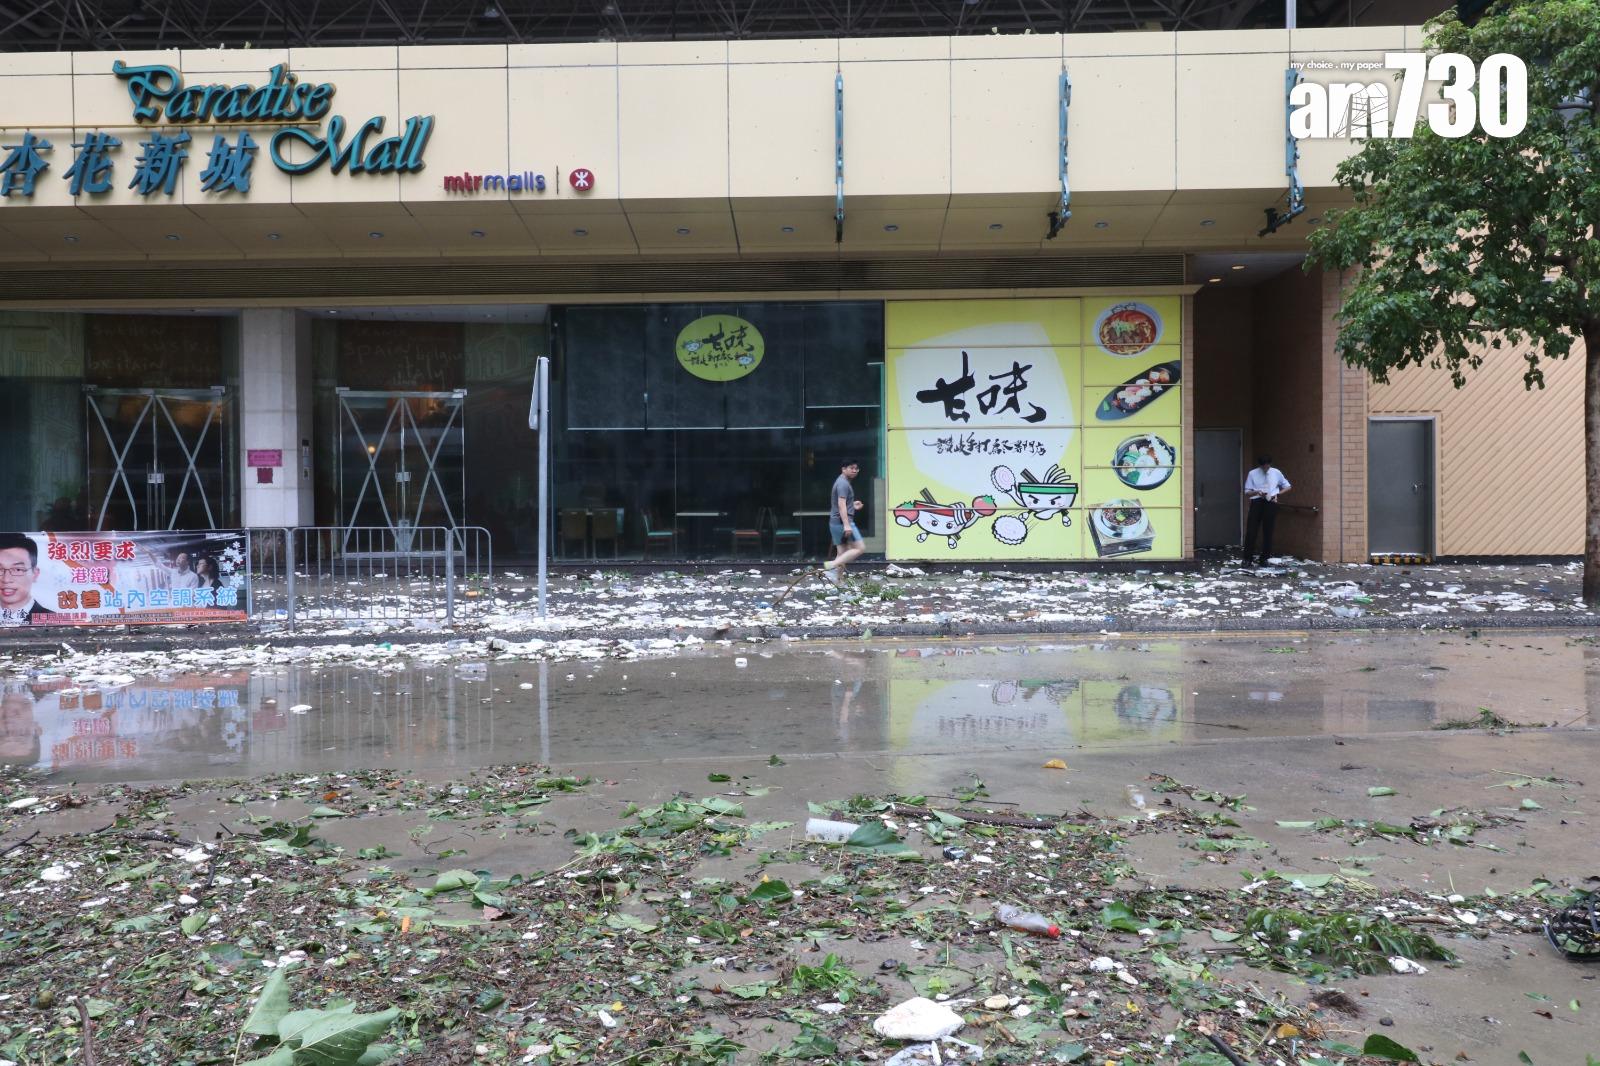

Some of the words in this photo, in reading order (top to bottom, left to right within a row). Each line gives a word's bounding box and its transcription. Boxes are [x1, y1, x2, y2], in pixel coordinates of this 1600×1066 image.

[112, 60, 336, 123] Paradise
[0, 130, 260, 197] 杏花新城
[270, 115, 435, 176] Mall
[443, 171, 546, 192] mtrmalls
[47, 541, 136, 560] 強烈要求
[71, 567, 109, 583] 港鐵
